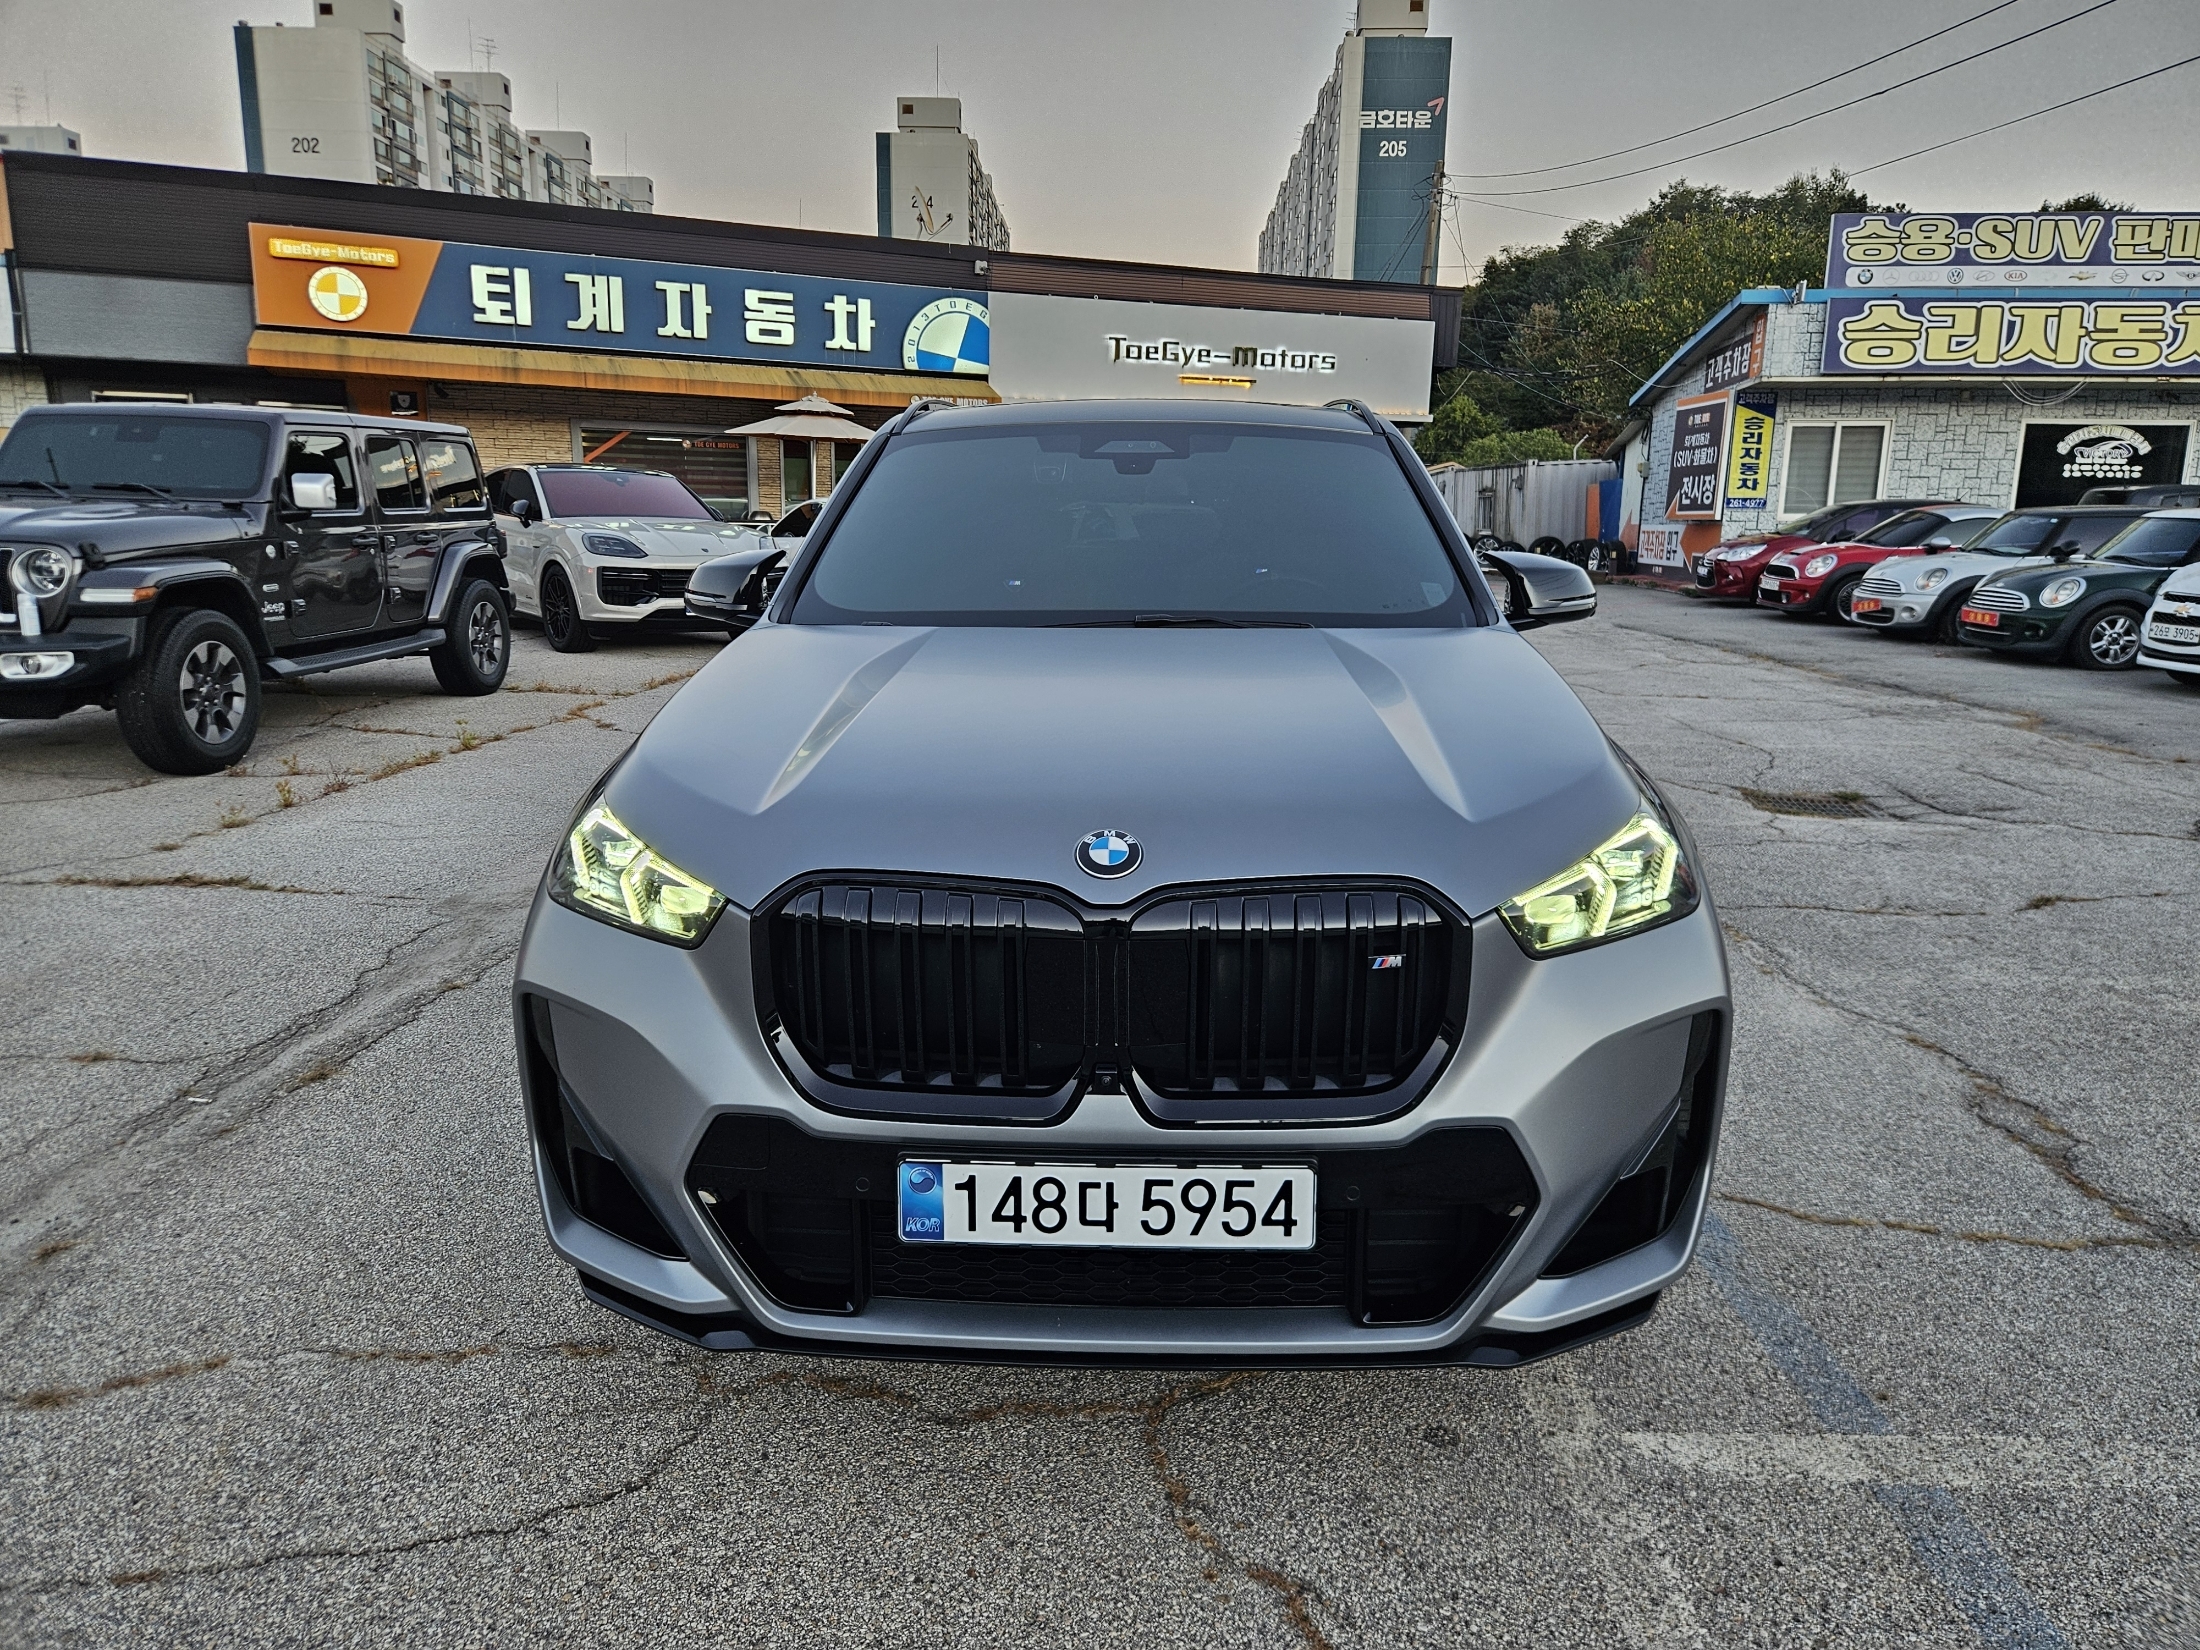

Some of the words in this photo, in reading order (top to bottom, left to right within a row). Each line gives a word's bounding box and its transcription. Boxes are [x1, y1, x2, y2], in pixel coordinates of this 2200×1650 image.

[1359, 109, 1432, 128] 금호타운
[291, 137, 320, 154] 202
[1379, 140, 1407, 157] 205
[911, 195, 934, 208] 24
[272, 240, 396, 263] ToeGye-Motors
[2006, 270, 2025, 281] KIA
[1108, 335, 1336, 370] ToeGye-Motors
[1705, 341, 1752, 388] 고객주차장
[1681, 474, 1715, 505] 전시장
[1729, 499, 1764, 508] 261-4977
[261, 601, 285, 614] Jeep
[2172, 627, 2195, 640] 3905
[1084, 830, 1136, 844] BMW
[954, 1174, 1119, 1235] 148다
[1140, 1178, 1298, 1237] 5954
[905, 1216, 941, 1233] KOR
